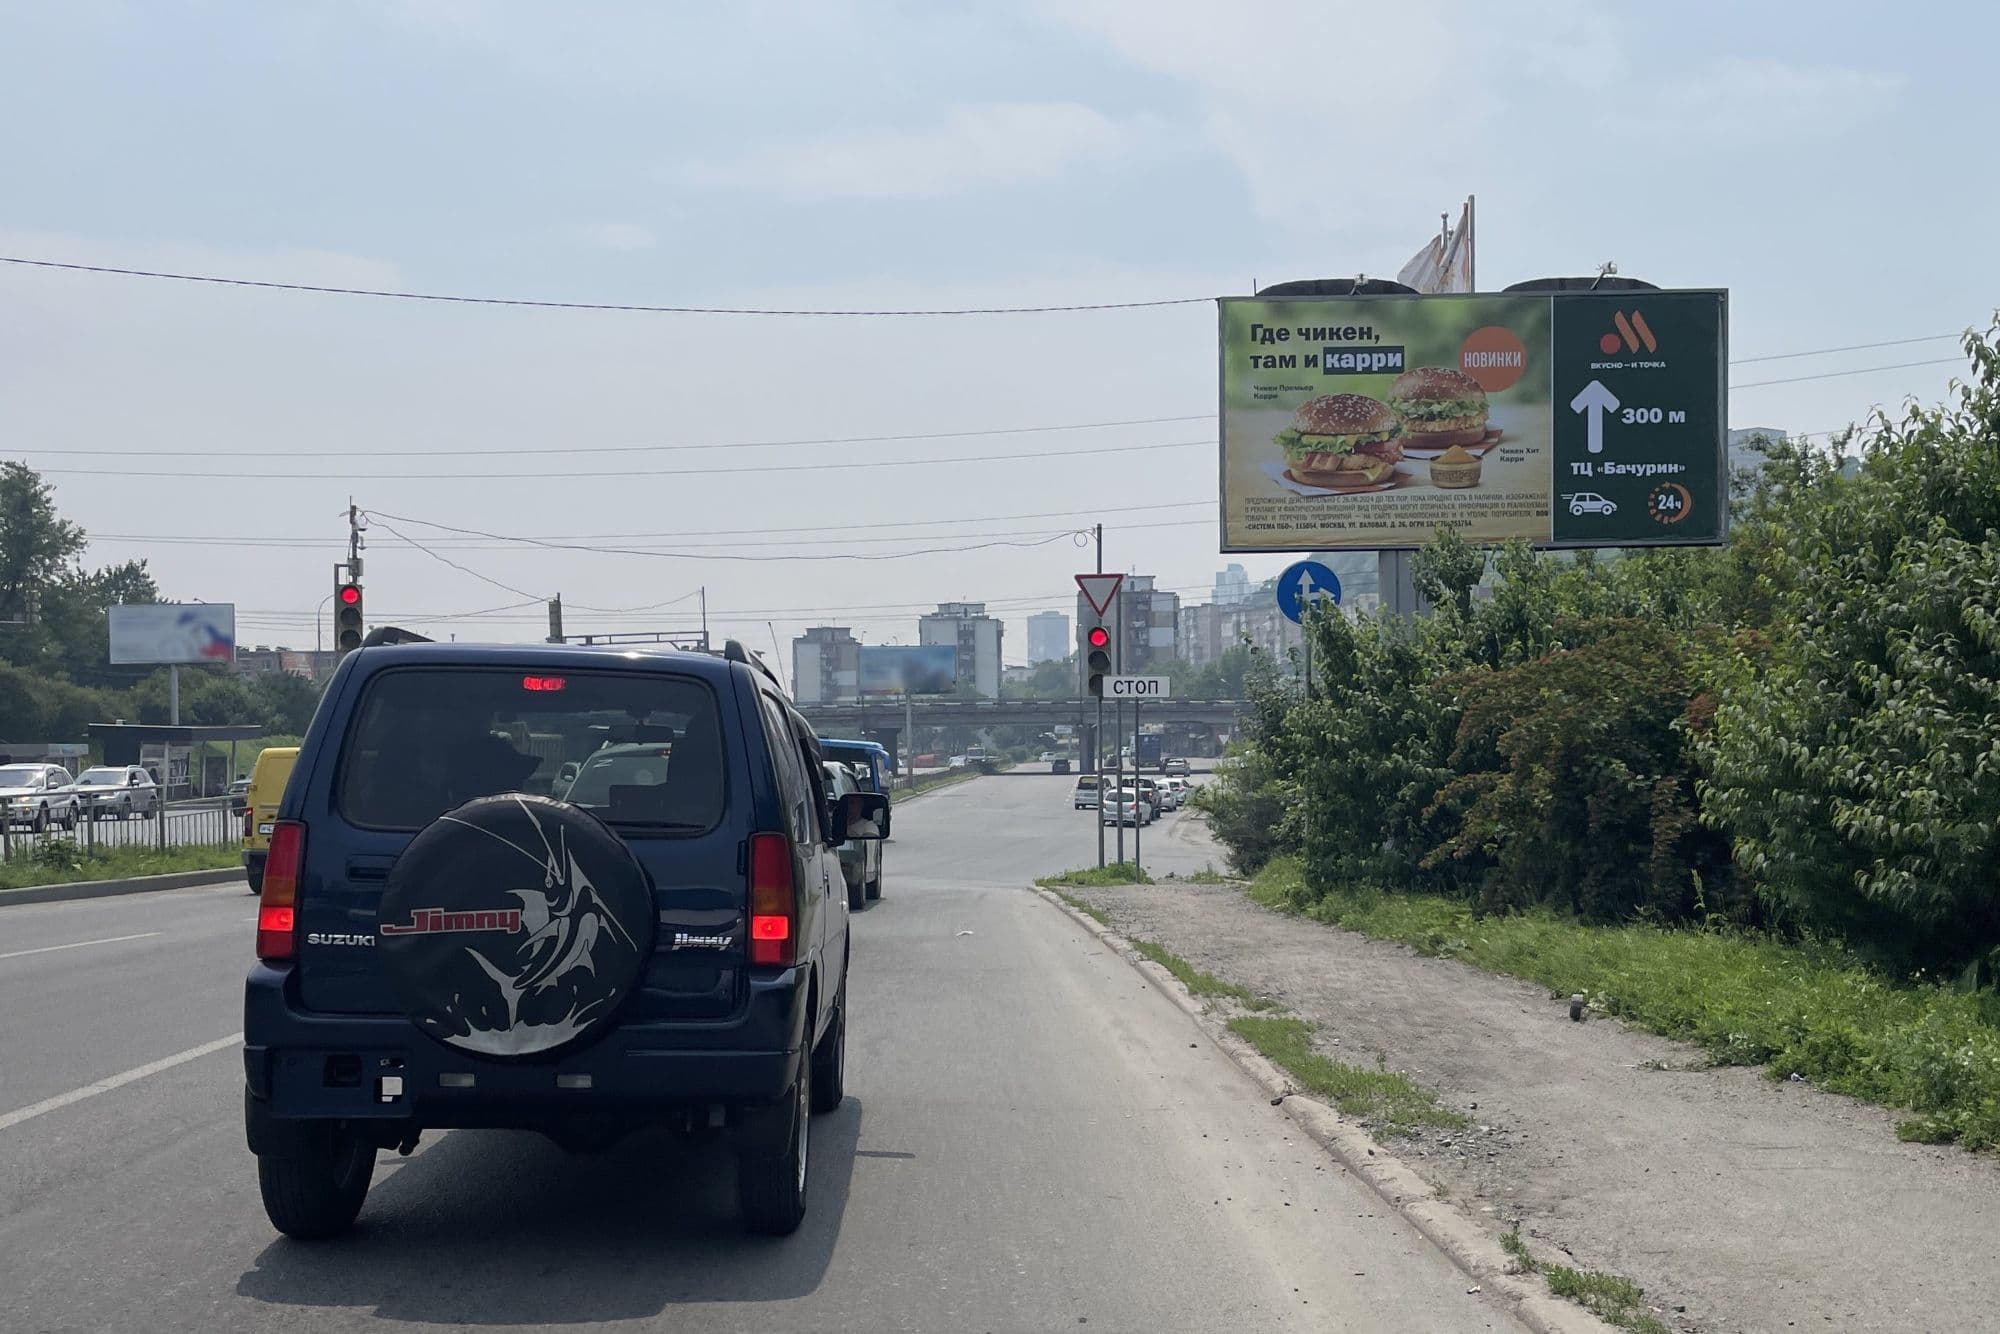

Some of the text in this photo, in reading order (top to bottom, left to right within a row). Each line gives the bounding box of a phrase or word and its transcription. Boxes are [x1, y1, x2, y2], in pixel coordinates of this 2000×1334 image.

[1250, 324, 1380, 345] Где чикен,
[1250, 352, 1402, 371] там и карри
[1464, 351, 1521, 368] НОВИНКИ
[1279, 384, 1314, 392] Премьер
[1621, 408, 1686, 424] 300 м
[1571, 462, 1686, 477] ТЦ «Бачурин»
[1113, 680, 1158, 695] СТОП
[380, 907, 521, 936] Jimny
[307, 933, 376, 946] SUZUKI
